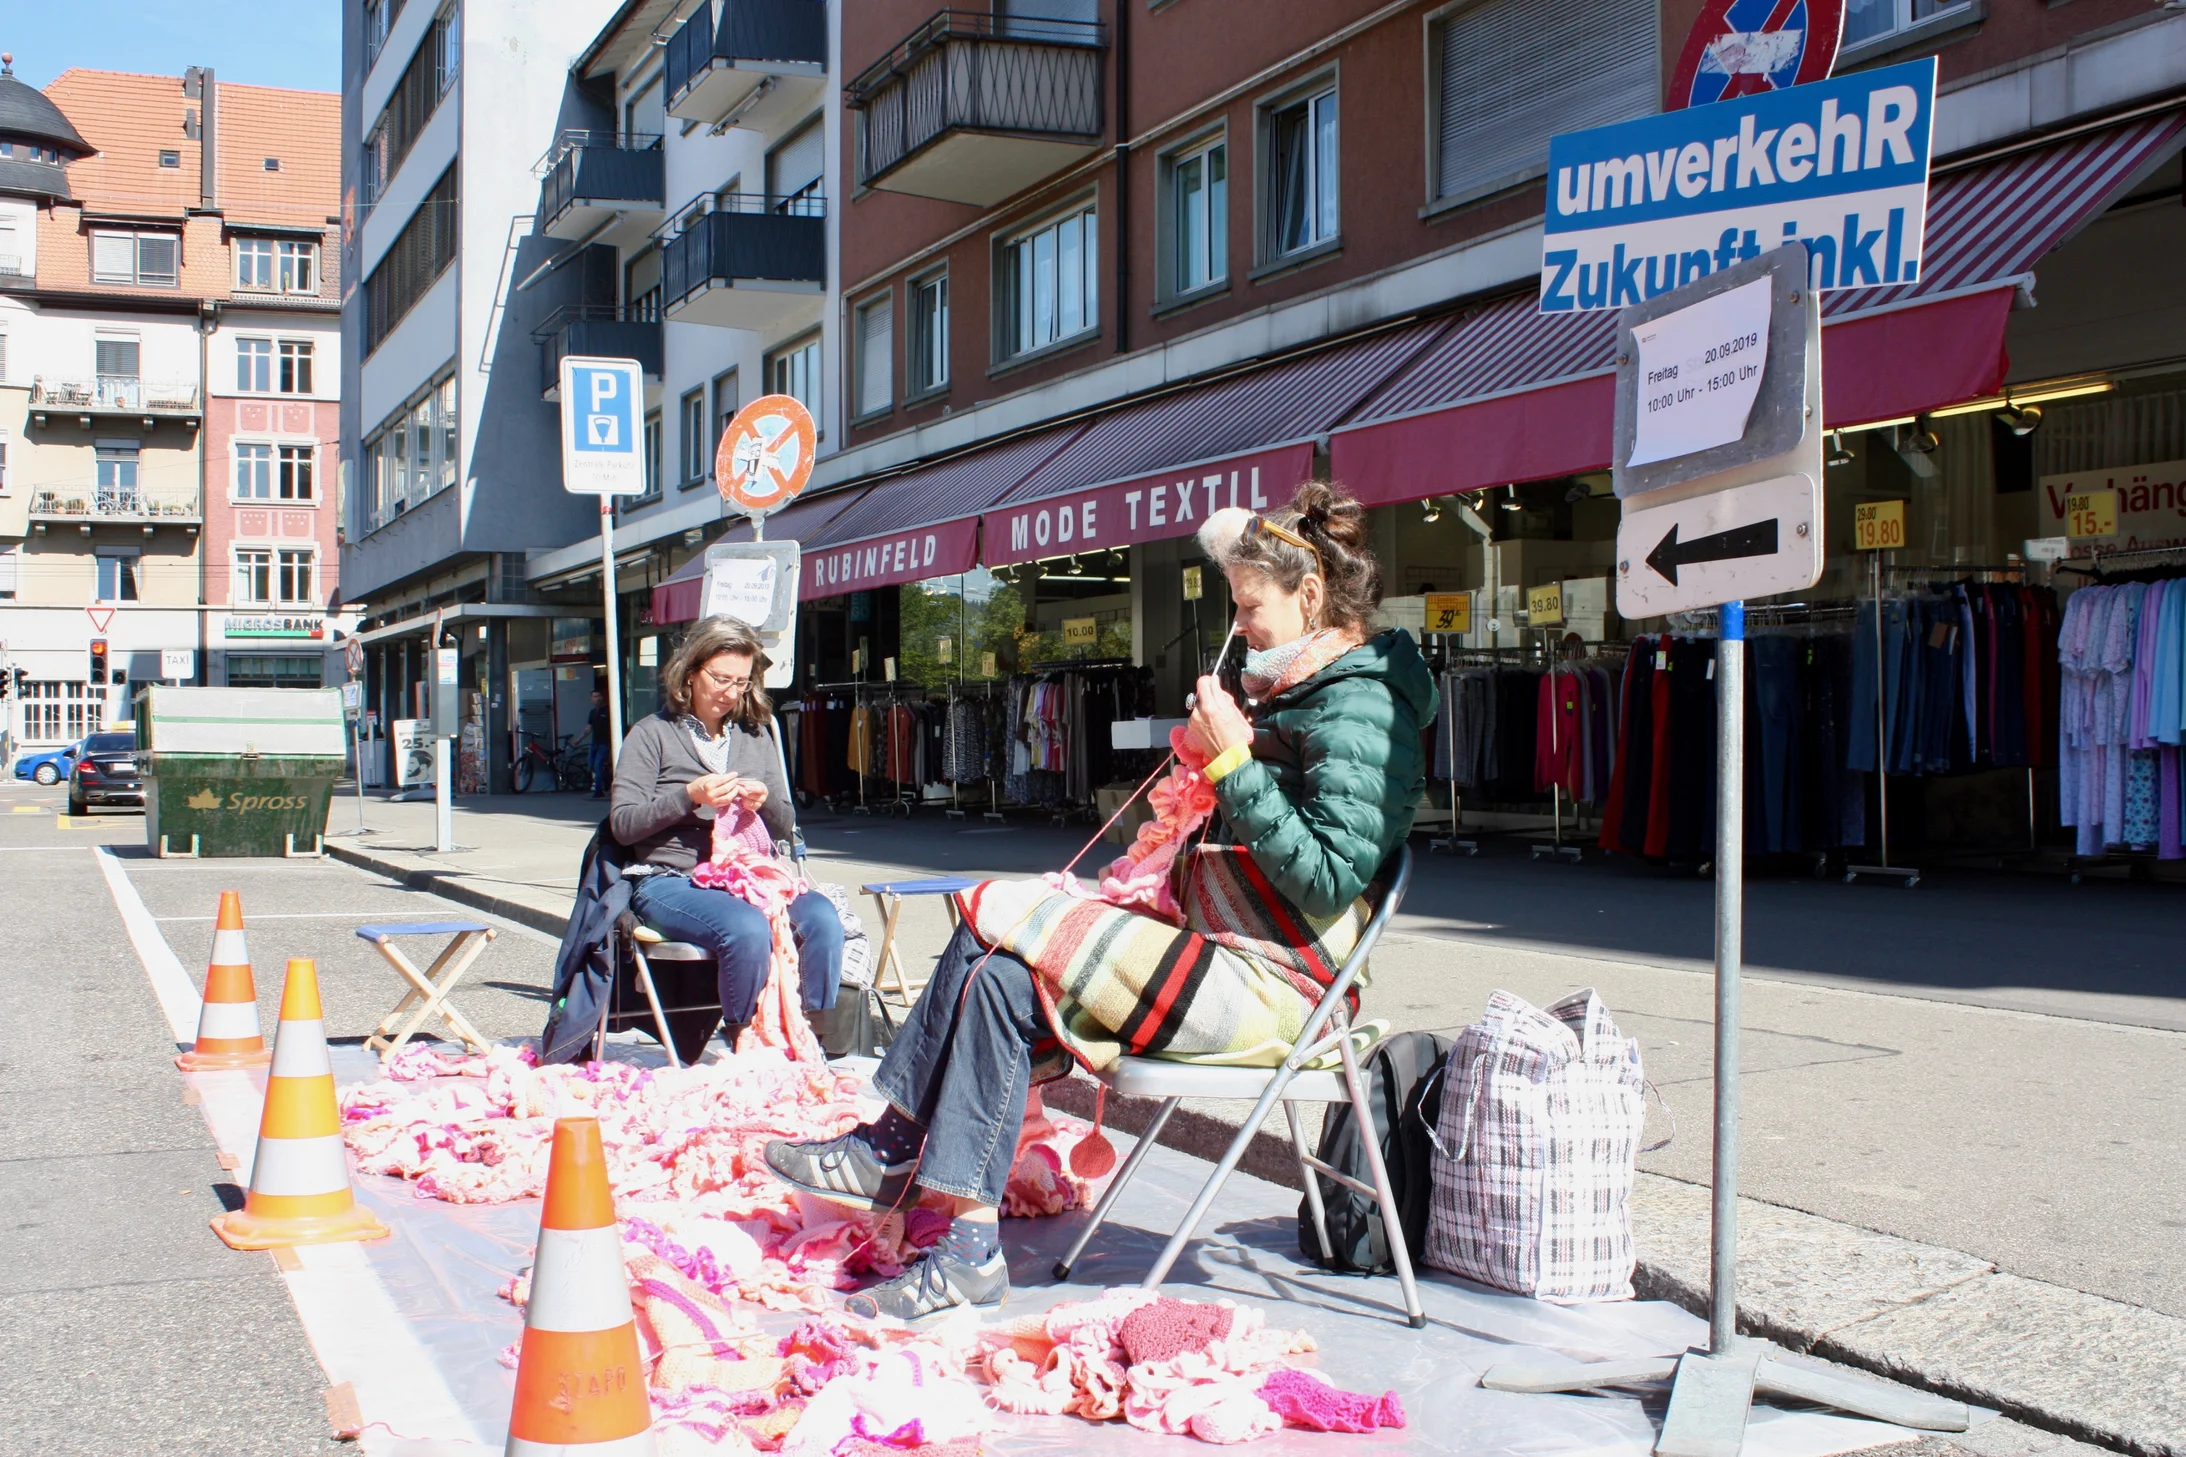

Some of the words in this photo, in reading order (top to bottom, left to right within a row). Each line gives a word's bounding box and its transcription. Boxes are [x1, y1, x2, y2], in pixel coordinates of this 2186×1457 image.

[1556, 84, 1919, 216] umverkehR
[1540, 226, 1761, 312] Zukunft
[1647, 364, 1679, 386] Freitag
[1704, 332, 1758, 365] 20.09.2019
[591, 372, 617, 412] P
[1647, 392, 1674, 414] 10:00
[1677, 387, 1695, 403] Uhr
[1706, 370, 1736, 393] 15:00
[1739, 364, 1758, 381] Uhr
[1011, 500, 1097, 551] MODE
[1125, 467, 1268, 531] TEXTIL
[2046, 475, 2186, 520] Vhäng
[1858, 519, 1900, 546] 19.80
[2073, 511, 2112, 536] 15.-
[815, 534, 937, 587] RUBINFELD
[716, 581, 732, 590] Freitag
[744, 581, 770, 590] 20.09.2019
[1531, 596, 1559, 614] 39.80
[225, 618, 324, 630] MIGROSBANK
[1066, 625, 1094, 638] 10.00
[166, 655, 189, 665] TAXI
[402, 738, 436, 750] 25.-
[226, 792, 308, 815] Spross
